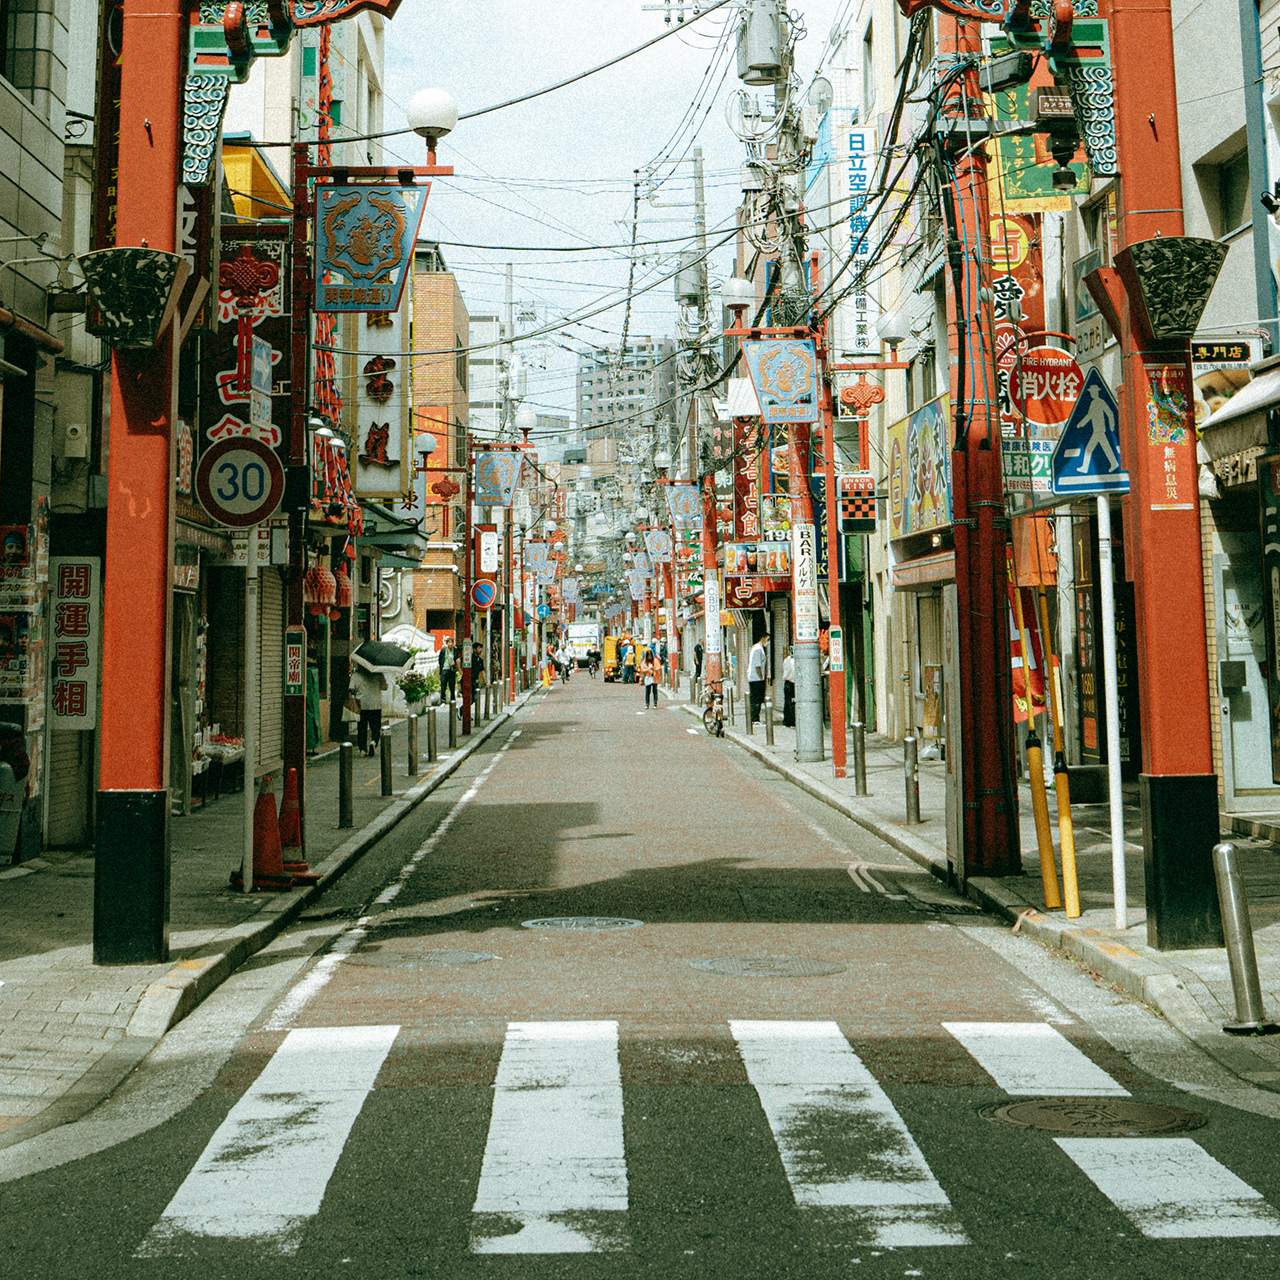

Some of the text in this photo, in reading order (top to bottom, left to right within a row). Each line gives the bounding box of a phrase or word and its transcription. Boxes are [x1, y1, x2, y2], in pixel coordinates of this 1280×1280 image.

[848, 133, 869, 255] 日立空調機器
[1022, 357, 1072, 368] FIRE HYDRANT
[1195, 346, 1243, 360] 専門店
[1016, 371, 1080, 402] 消火栓
[217, 462, 264, 501] 30
[1163, 446, 1178, 500] 無病息災
[53, 563, 91, 716] 開運手相
